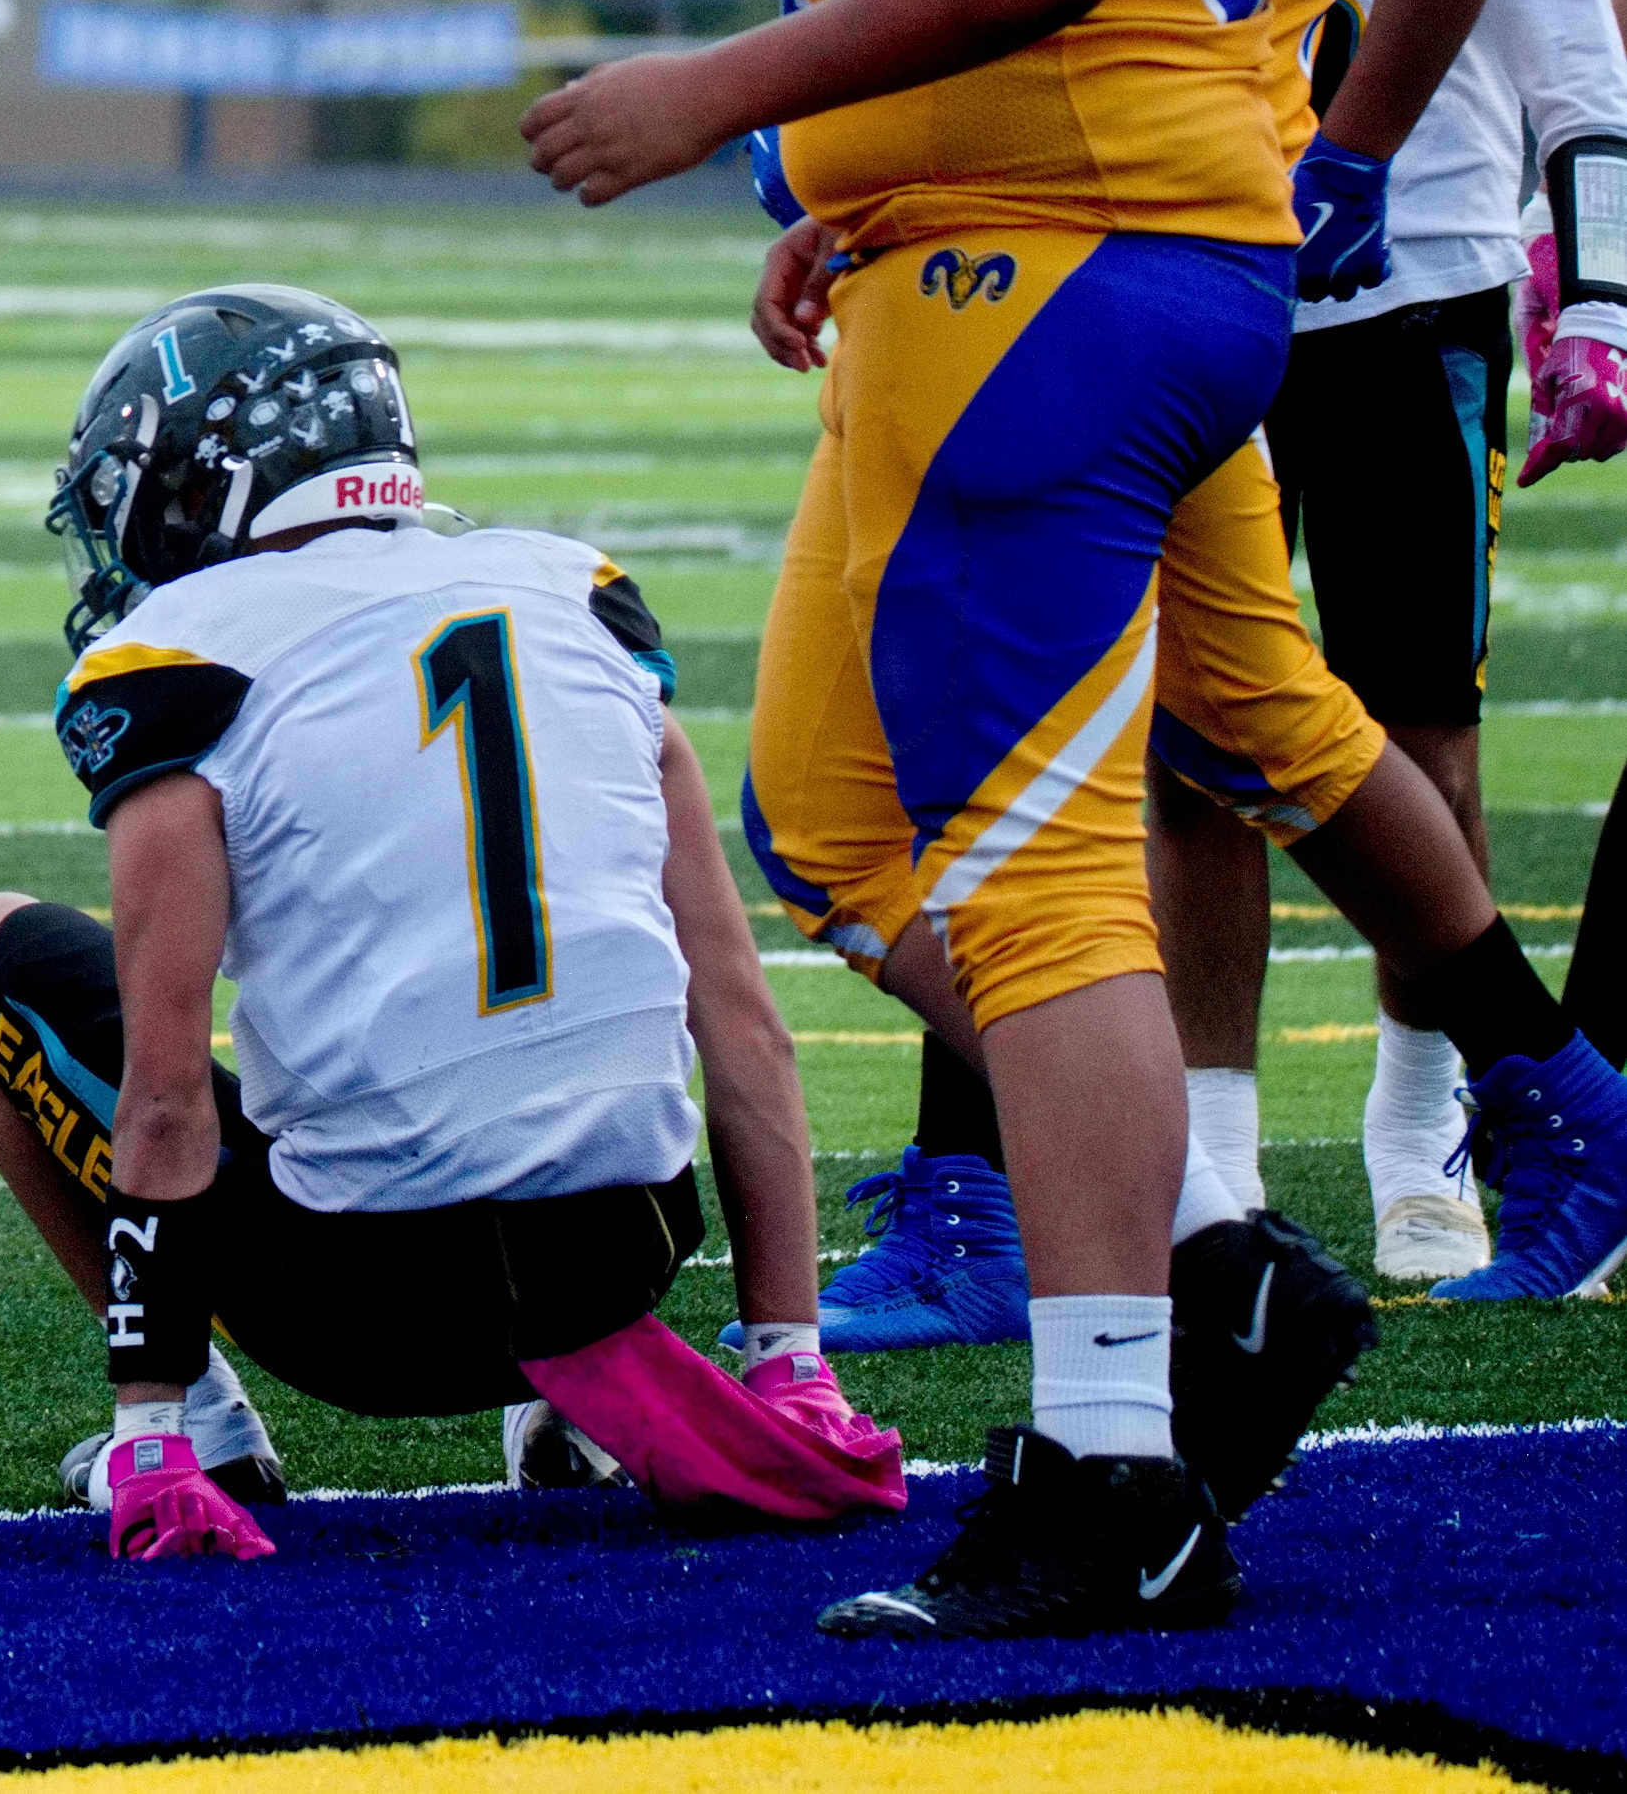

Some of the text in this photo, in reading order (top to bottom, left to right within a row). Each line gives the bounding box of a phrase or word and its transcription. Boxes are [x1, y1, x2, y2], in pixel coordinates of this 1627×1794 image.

[152, 325, 196, 406] 1
[336, 473, 424, 509] Ridde
[411, 606, 553, 1018] 1
[108, 1216, 158, 1347] H 2
